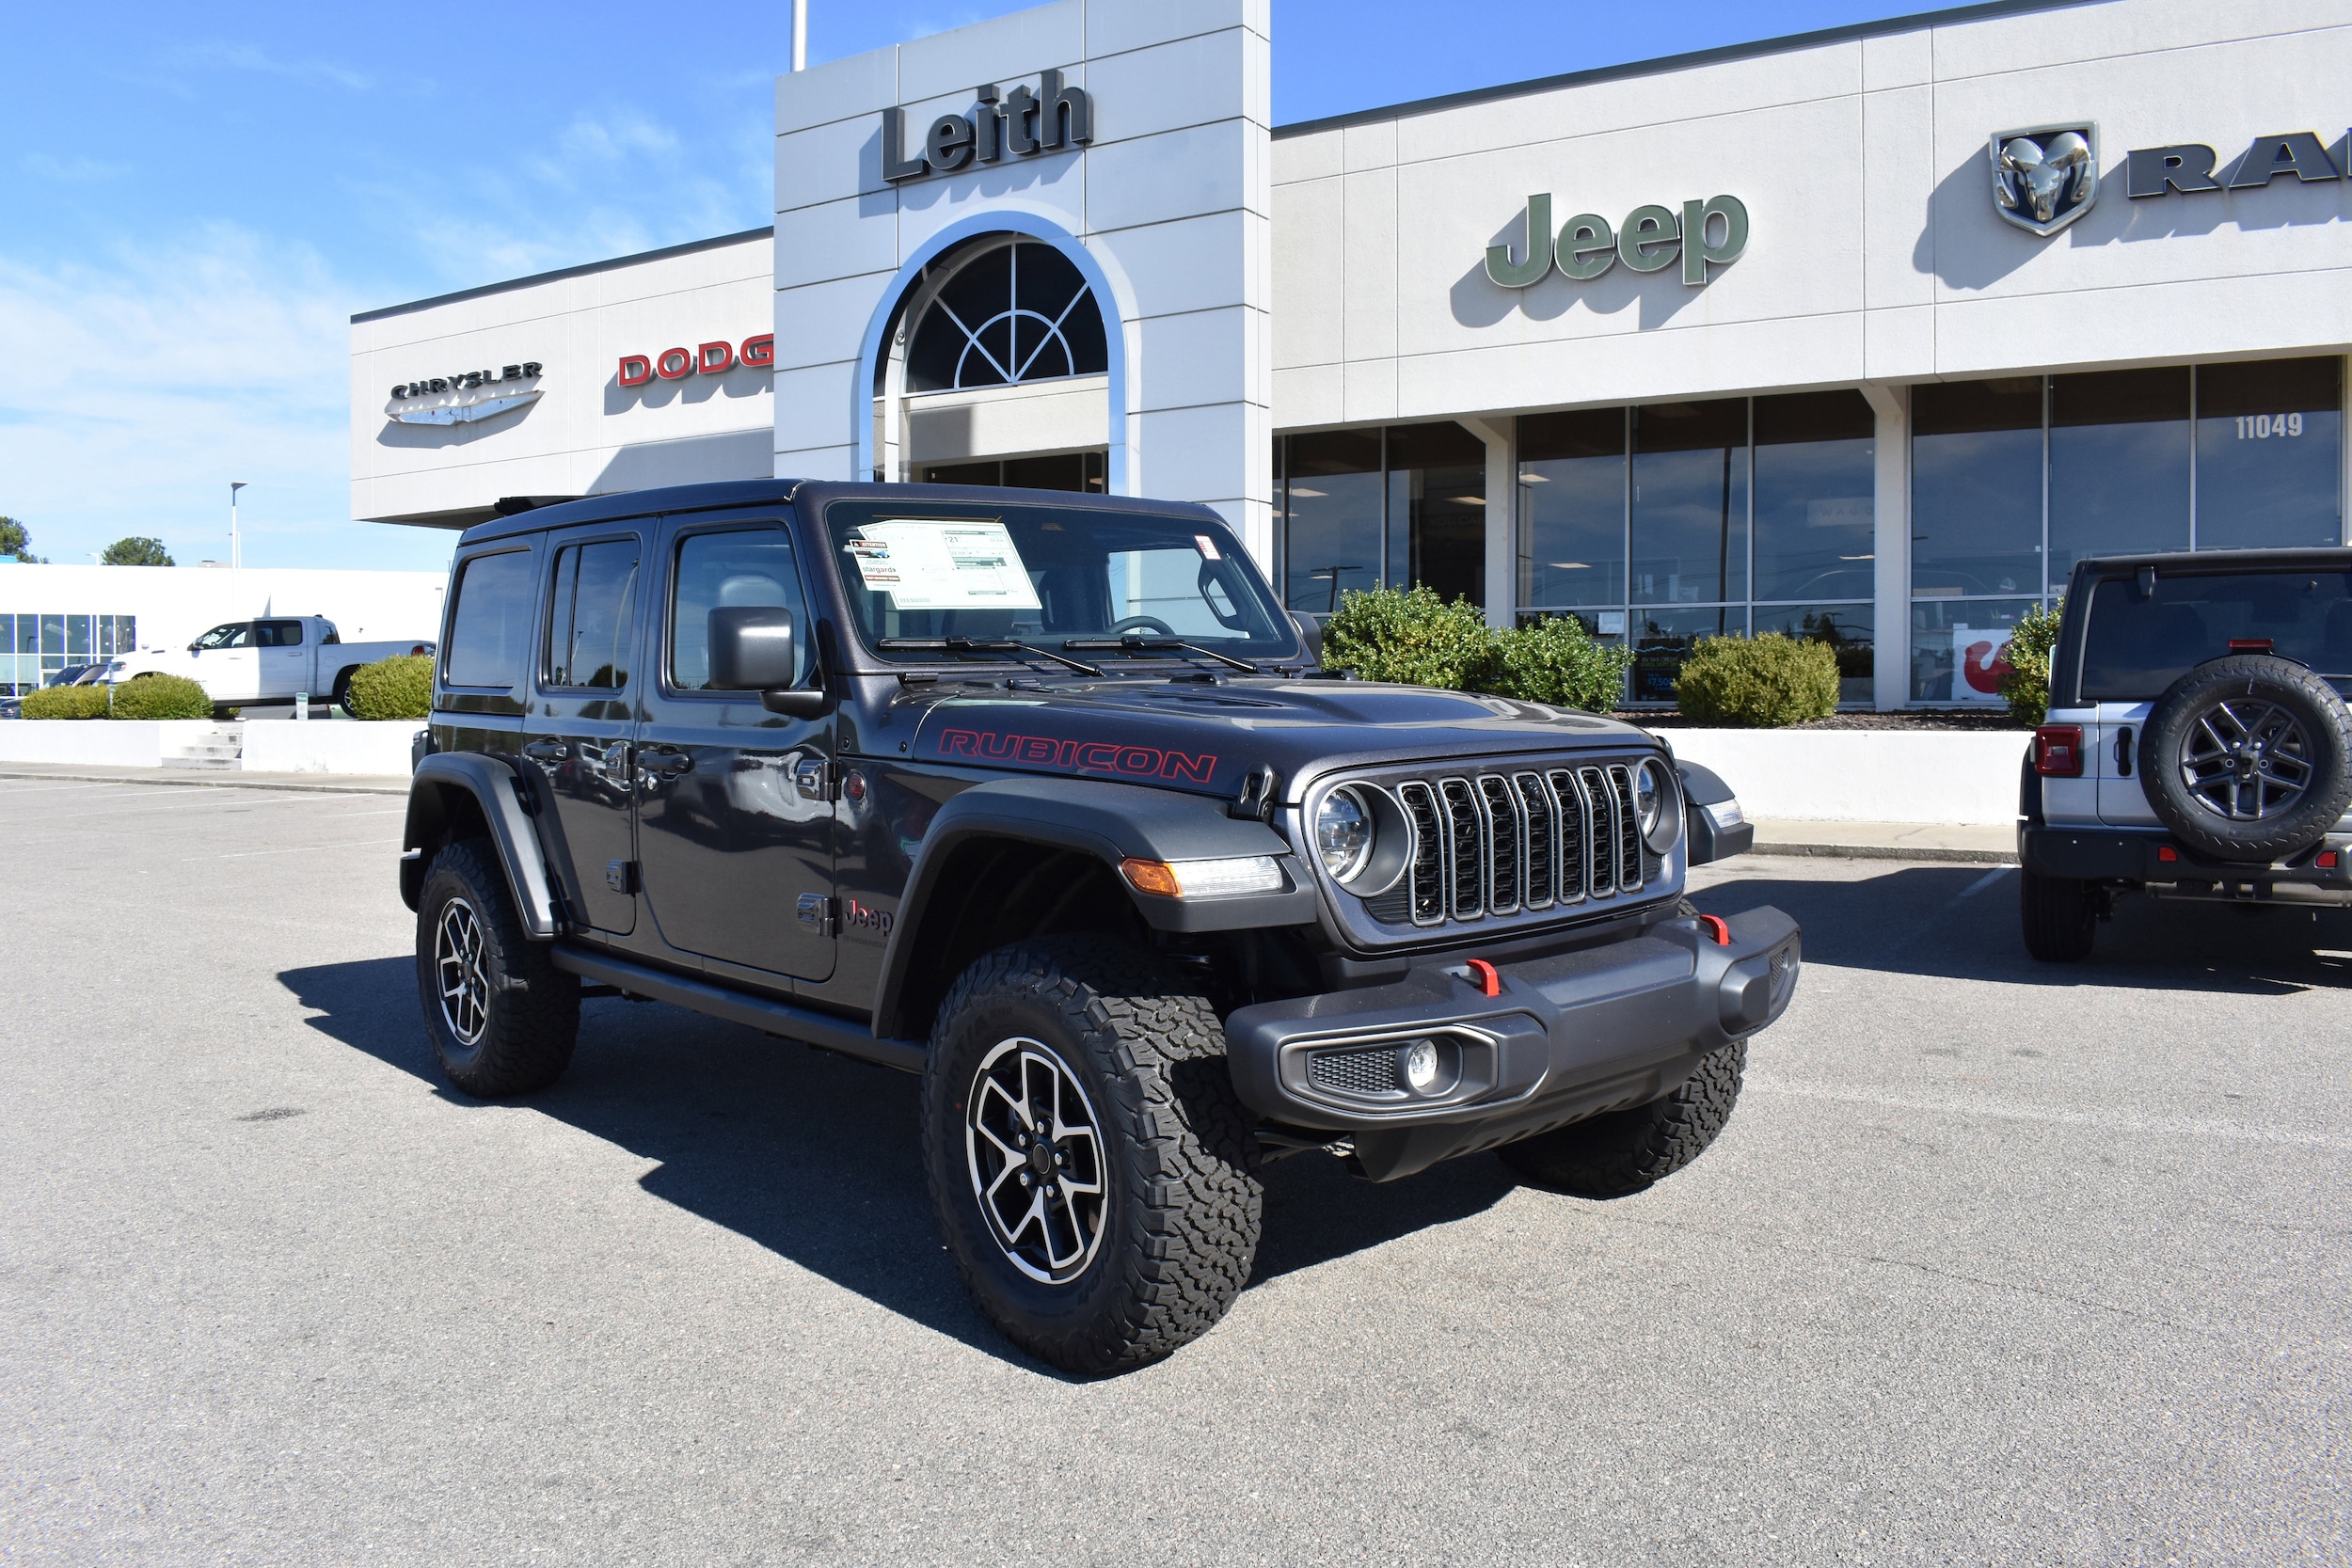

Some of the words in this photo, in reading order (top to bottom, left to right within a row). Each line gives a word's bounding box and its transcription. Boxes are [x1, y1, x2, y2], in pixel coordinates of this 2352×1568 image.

[882, 69, 1093, 182] Leith
[2127, 127, 2352, 198] RA
[1485, 192, 1751, 288] Jeep
[389, 361, 543, 400] CHRYSLER
[2235, 412, 2303, 439] 11049
[939, 729, 1217, 783] RUBICON
[844, 898, 894, 937] Jeep
